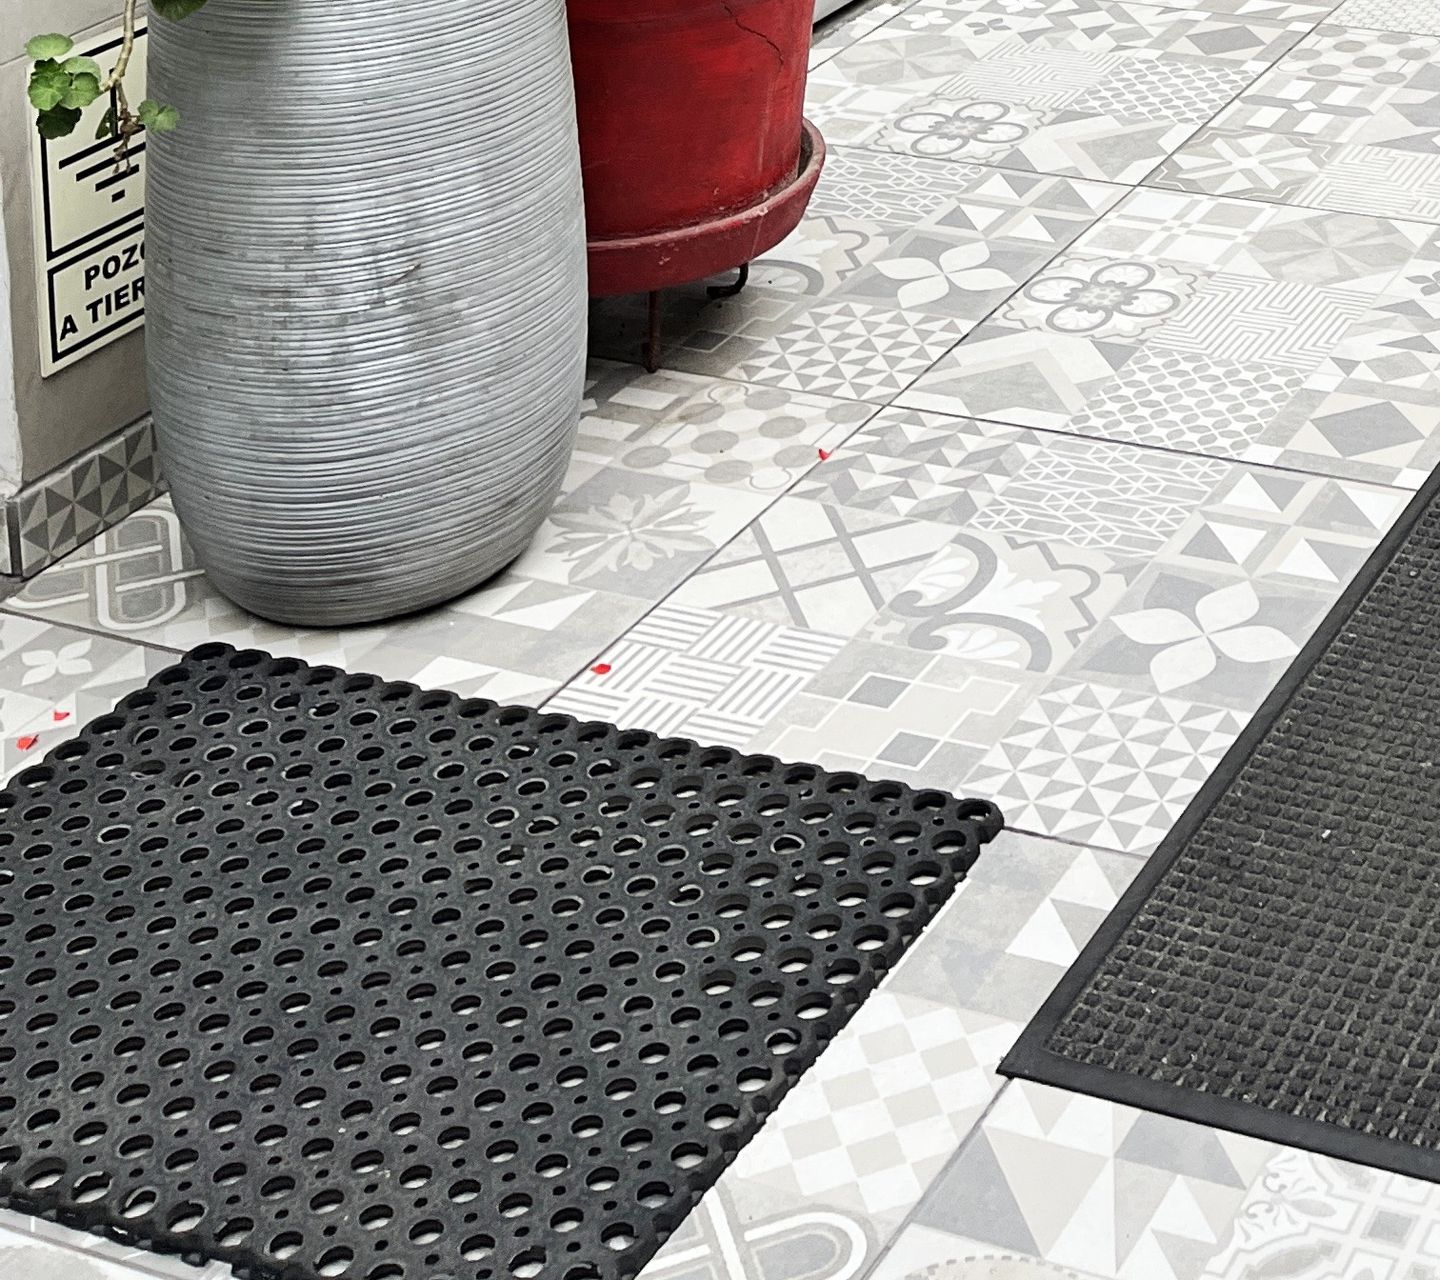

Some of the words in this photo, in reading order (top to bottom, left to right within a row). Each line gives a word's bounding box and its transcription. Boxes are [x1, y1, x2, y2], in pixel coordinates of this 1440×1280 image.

[85, 241, 145, 291] POZ
[60, 314, 78, 342] A
[86, 276, 145, 324] TIER
